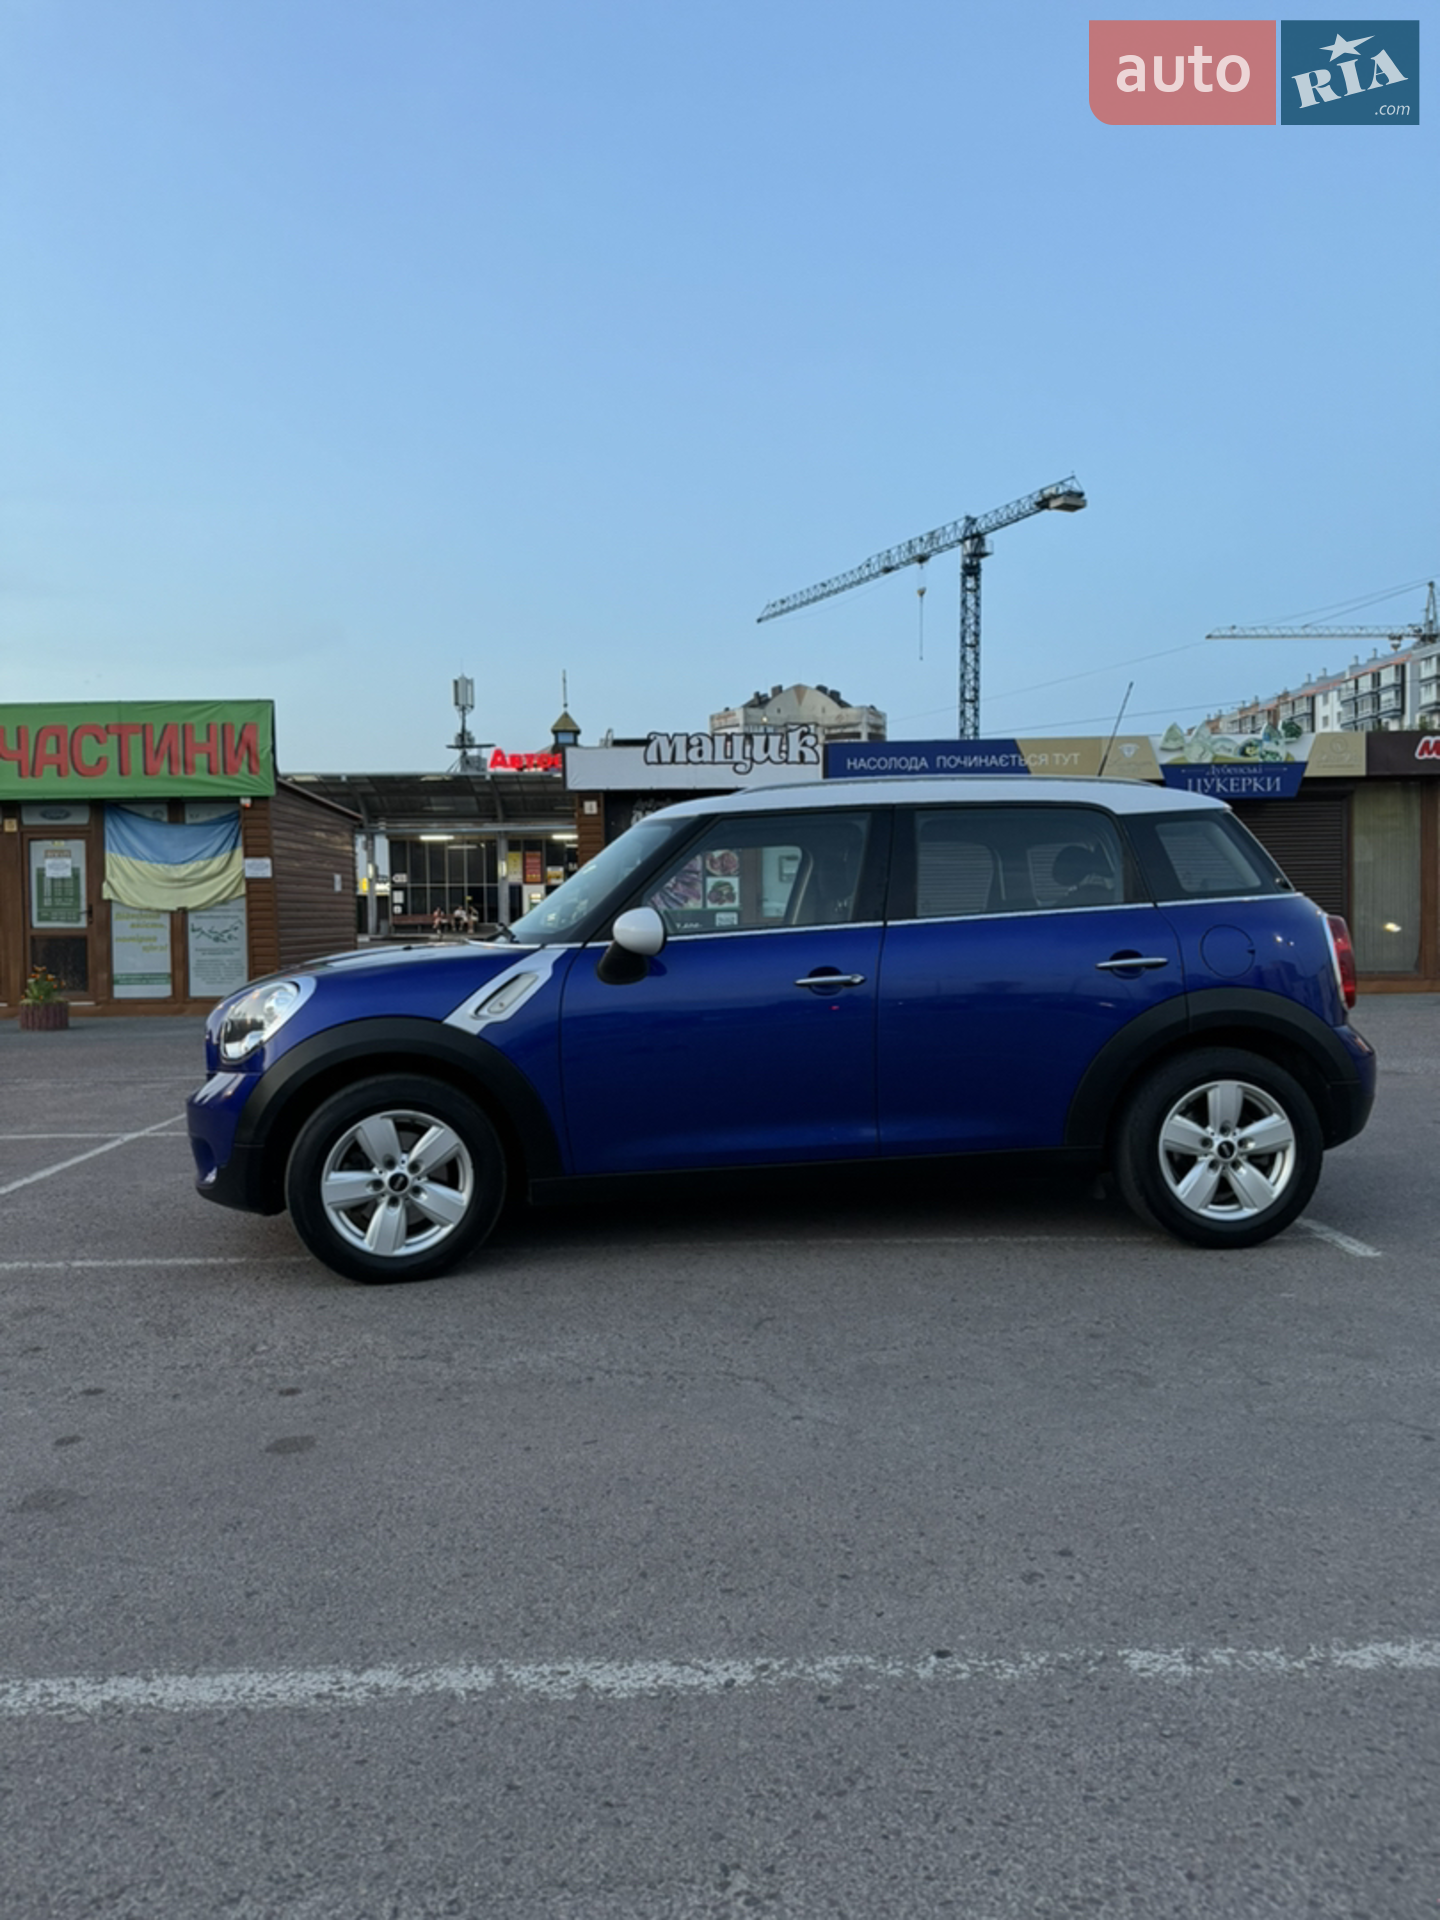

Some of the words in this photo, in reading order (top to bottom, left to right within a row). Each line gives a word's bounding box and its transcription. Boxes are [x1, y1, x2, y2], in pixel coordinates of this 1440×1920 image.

[0, 722, 260, 779] ЧАСТИНИ
[846, 757, 929, 771] НАСОЛОДА
[936, 753, 1048, 769] ПОЧИНАЄТЬСЯ
[1054, 753, 1080, 766] ТУТ
[1187, 776, 1281, 793] ЦУКЕРКИ
